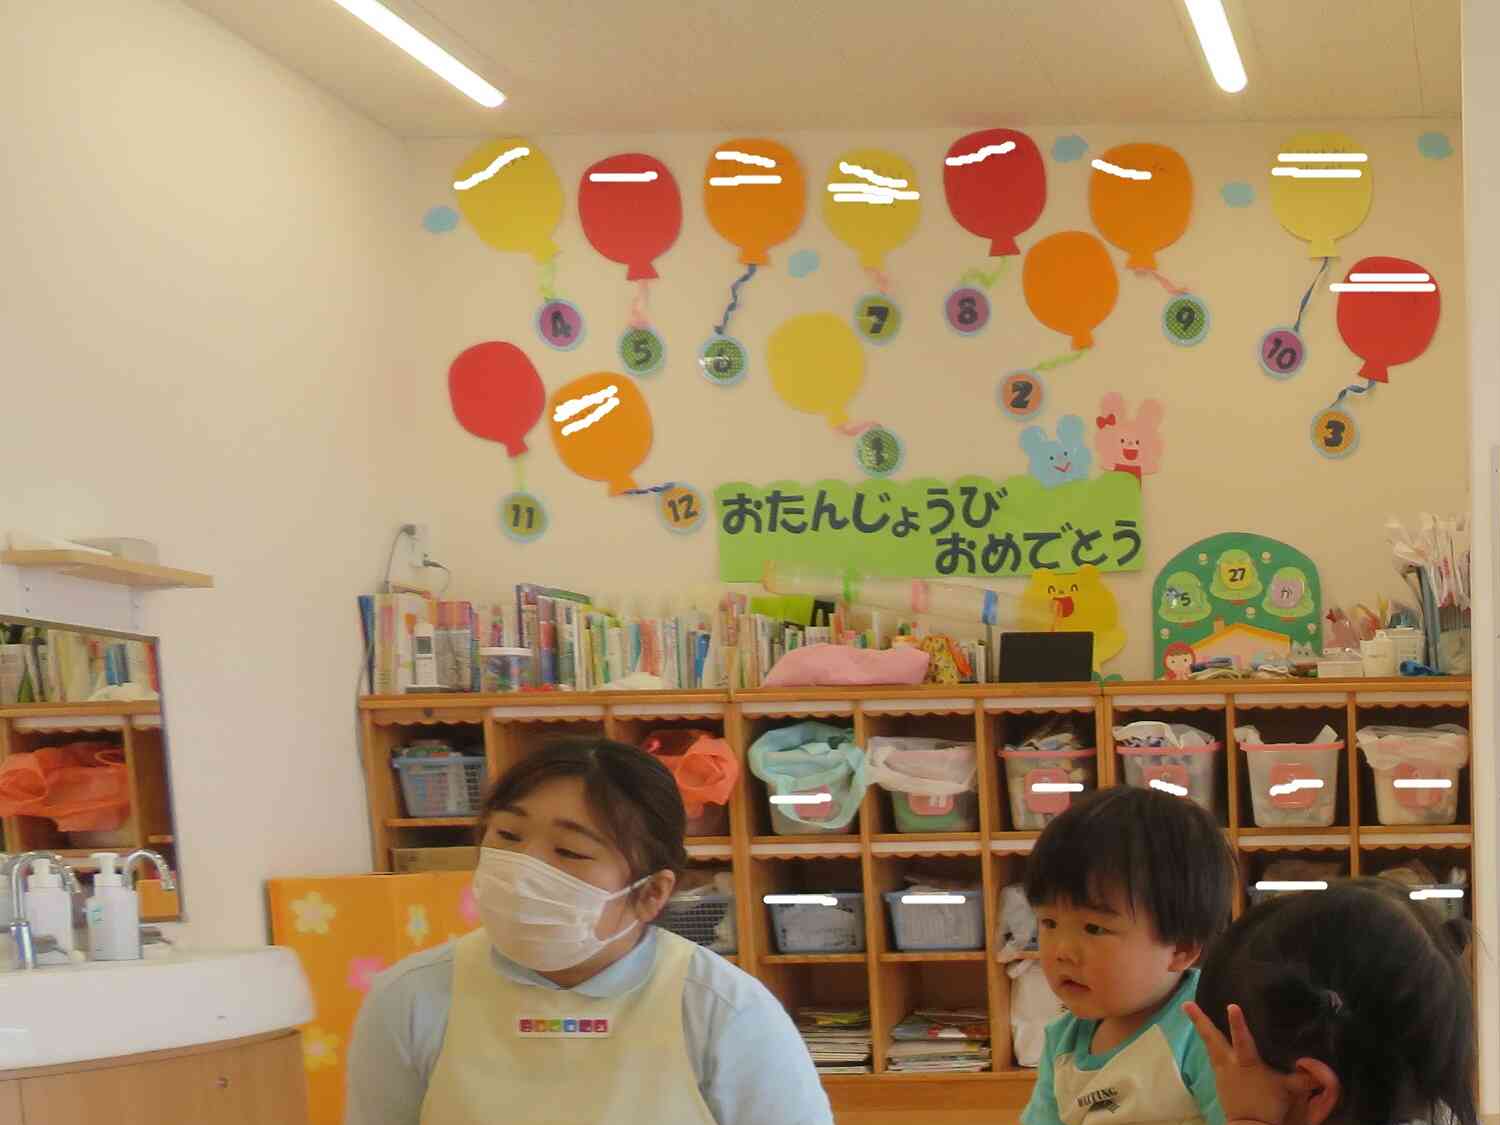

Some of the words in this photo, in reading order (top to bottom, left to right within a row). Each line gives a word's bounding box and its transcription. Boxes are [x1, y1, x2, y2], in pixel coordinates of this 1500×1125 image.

[551, 310, 572, 337] 4
[866, 306, 889, 333] 7
[957, 297, 978, 325] 8
[1176, 309, 1195, 331] 9
[633, 340, 652, 365] 5
[713, 344, 730, 373] 6
[1266, 338, 1297, 370] 10
[1011, 381, 1033, 409] 2
[1324, 421, 1345, 448] 3
[510, 503, 534, 529] 11
[667, 495, 698, 522] 12
[722, 486, 1009, 538] おたんじょうび
[935, 519, 1143, 576] おめでとう
[1229, 567, 1246, 582] 27
